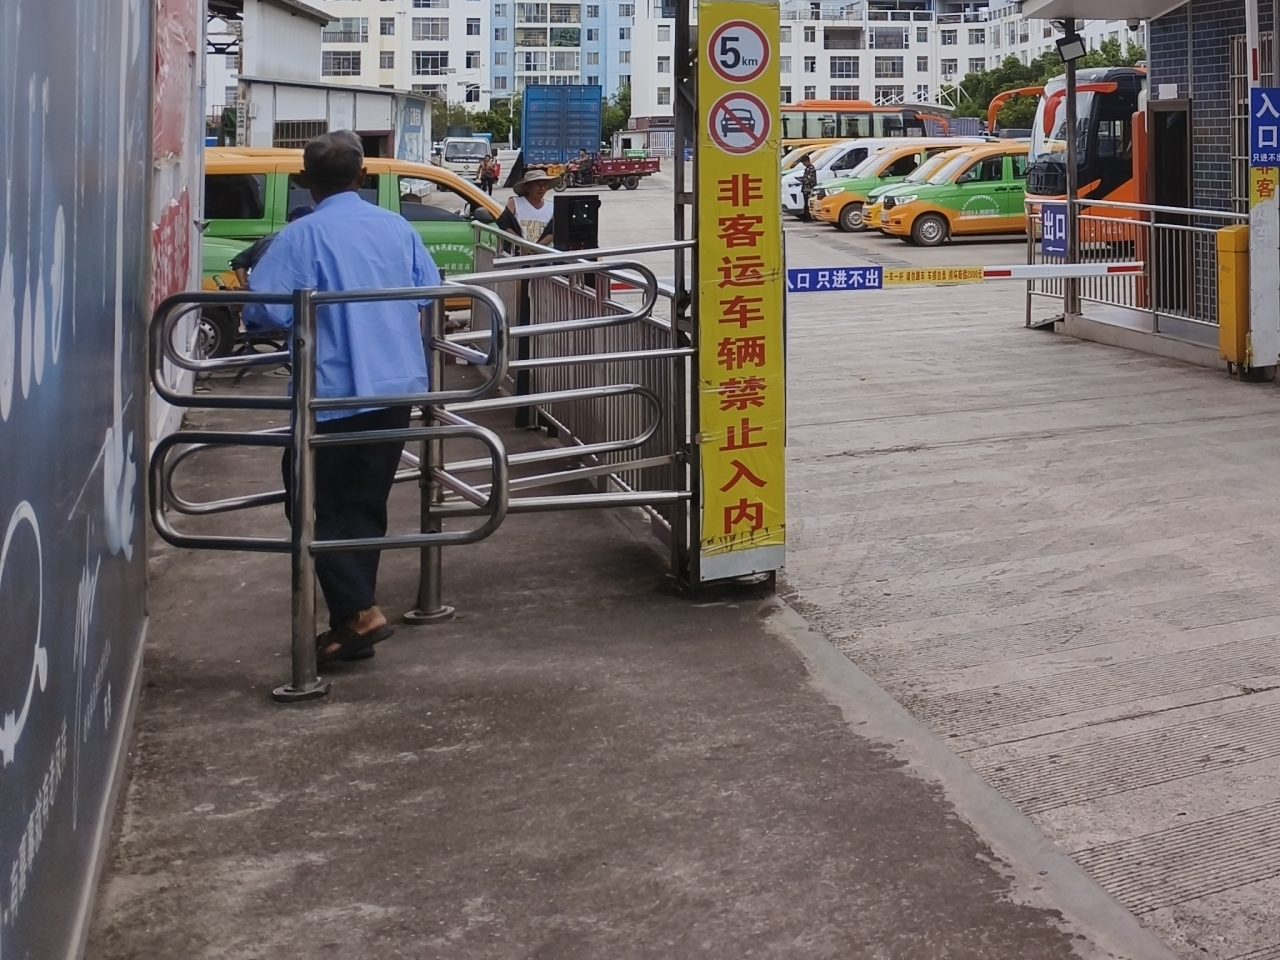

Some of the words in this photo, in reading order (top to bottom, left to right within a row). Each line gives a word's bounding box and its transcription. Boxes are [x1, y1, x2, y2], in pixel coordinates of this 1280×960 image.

[1255, 92, 1280, 148] 入口
[1044, 210, 1066, 241] 出口
[816, 268, 879, 288] 只进不出
[716, 173, 768, 534] 非客运车辆禁止入内
